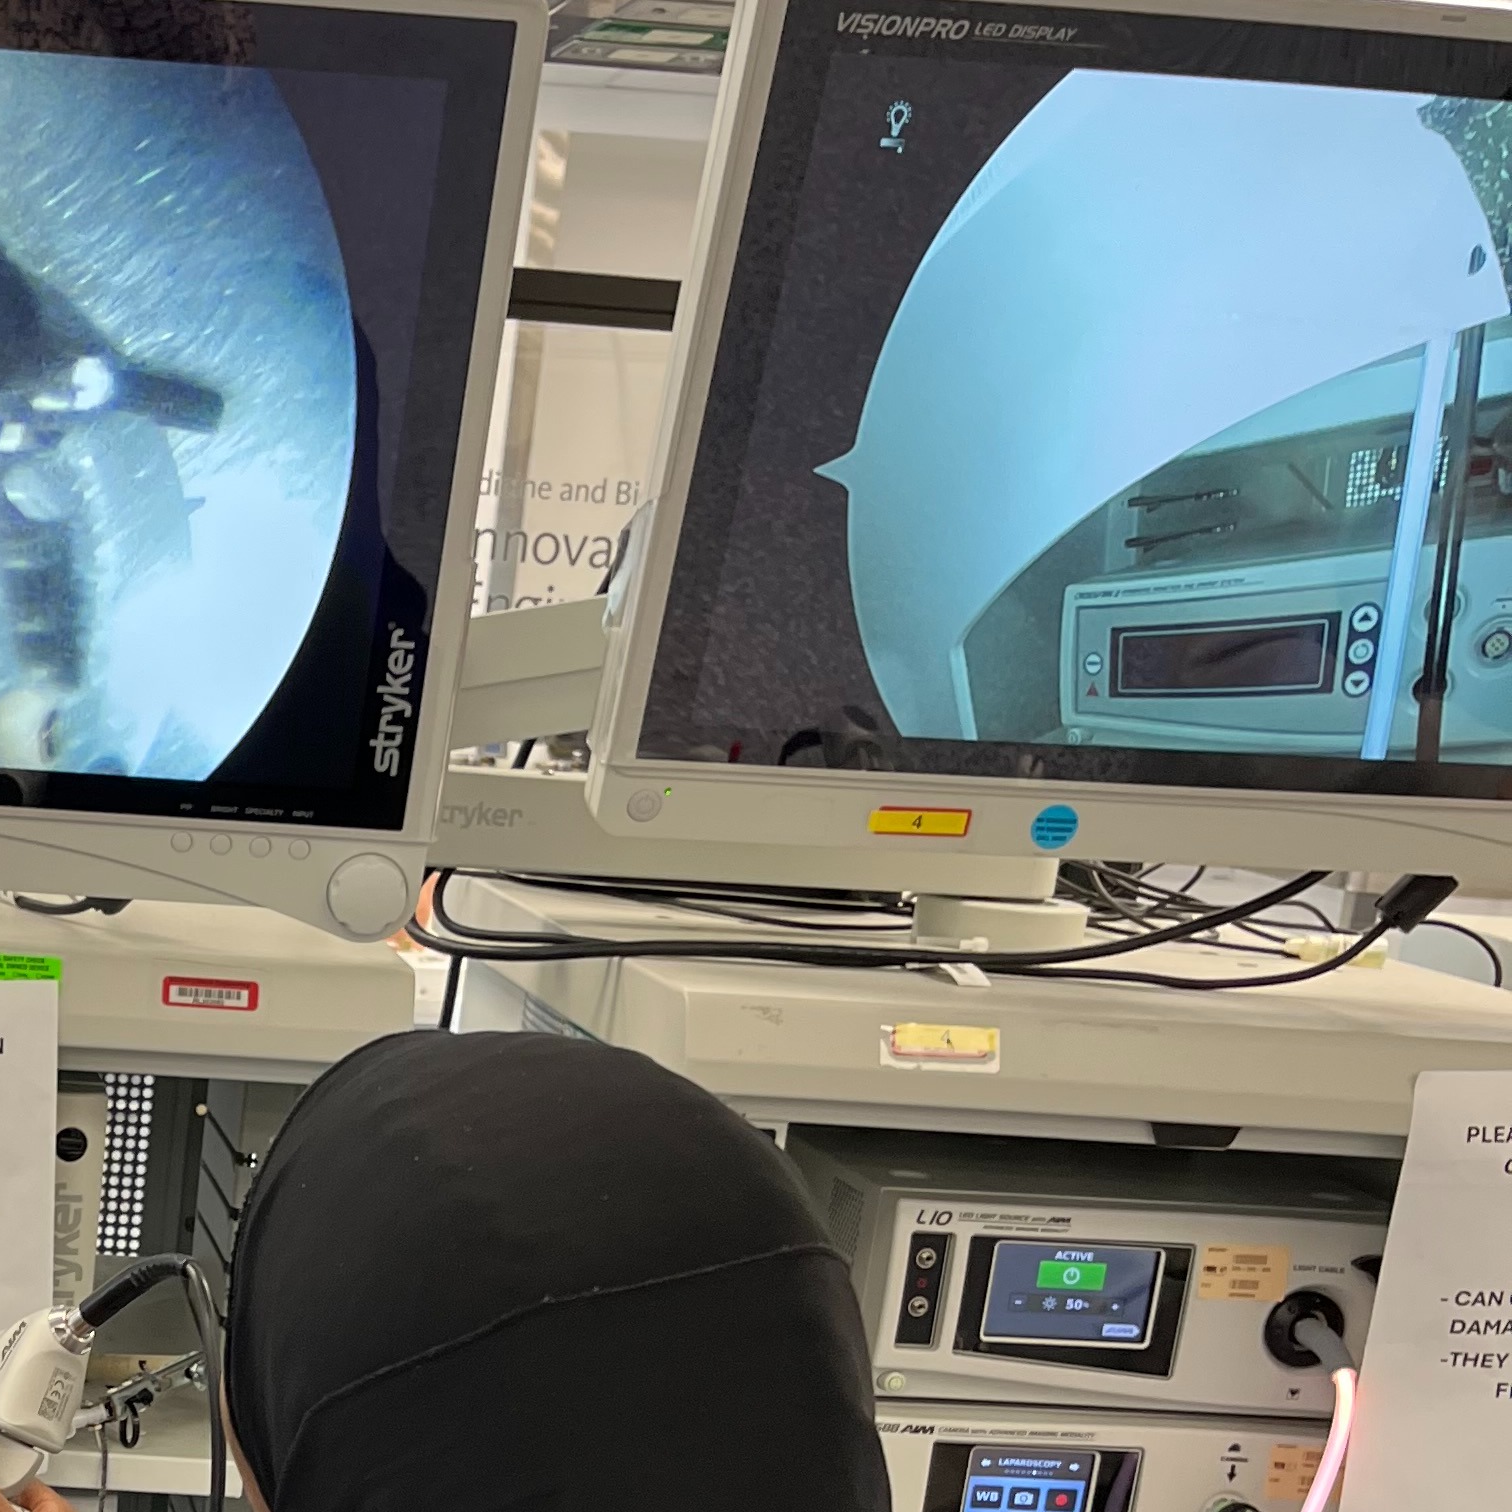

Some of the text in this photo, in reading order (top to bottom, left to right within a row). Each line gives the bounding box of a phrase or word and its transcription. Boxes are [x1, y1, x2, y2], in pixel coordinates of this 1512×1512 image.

[837, 12, 1078, 42] VISIONPRO LED DISPLAY
[559, 478, 608, 504] and
[369, 628, 416, 777] stryker
[911, 815, 923, 829] 4
[1054, 1250, 1094, 1262] ACTIVE
[1454, 1290, 1505, 1307] CAN
[1440, 1351, 1510, 1369] -THEY
[998, 1457, 1062, 1469] LAPAROSCOPY
[976, 1490, 999, 1503] WB
